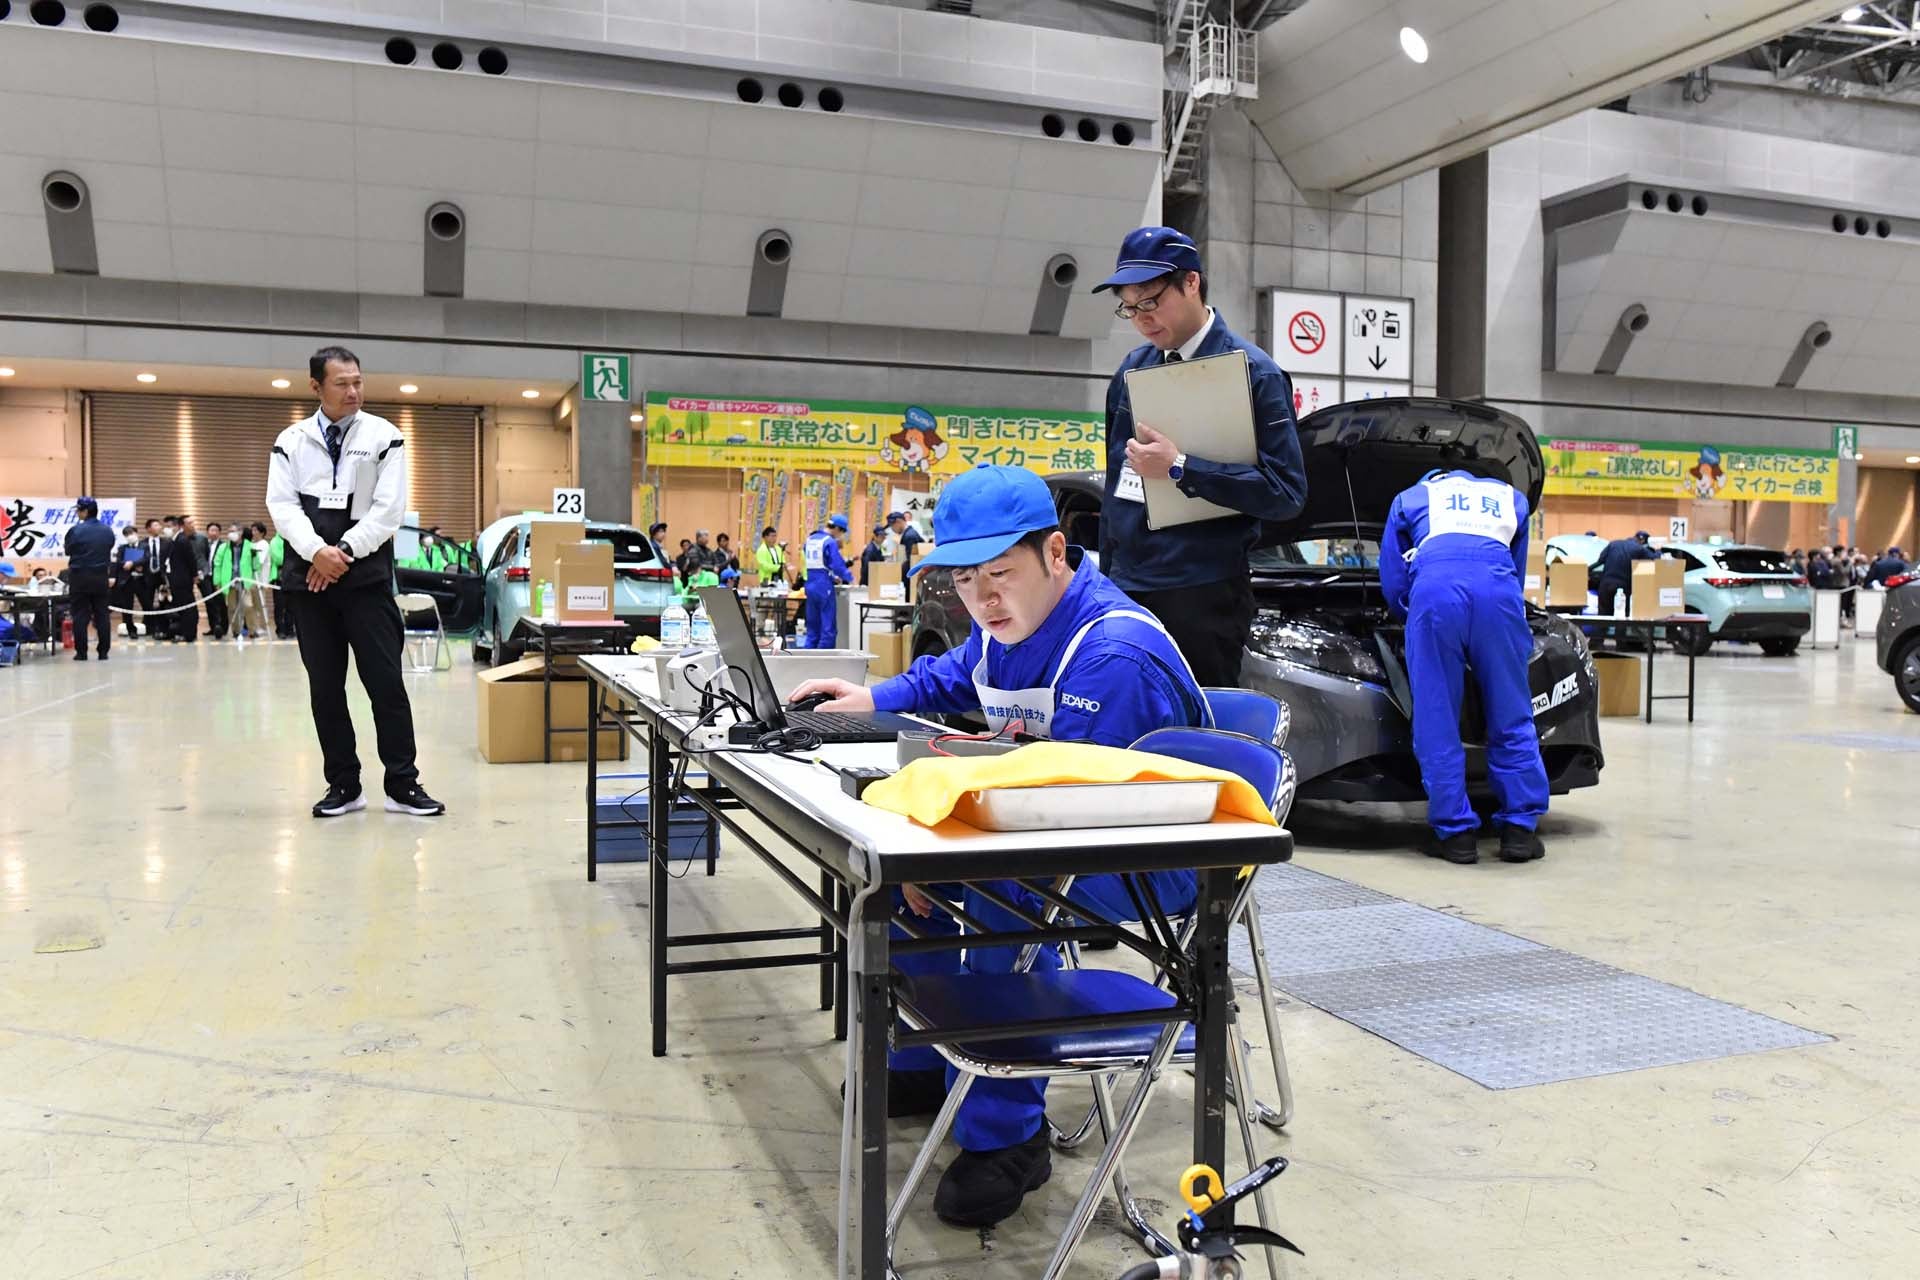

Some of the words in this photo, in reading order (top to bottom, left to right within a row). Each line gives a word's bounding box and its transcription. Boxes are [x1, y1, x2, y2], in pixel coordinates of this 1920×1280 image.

[760, 419, 876, 445] 「異常なし」
[948, 416, 1105, 443] 聞きに行こうよ
[958, 446, 1096, 469] マイカー点検
[1734, 477, 1823, 495] マイカー点検
[557, 493, 582, 514] 23
[1446, 493, 1502, 518] 北見
[1672, 521, 1685, 537] 21
